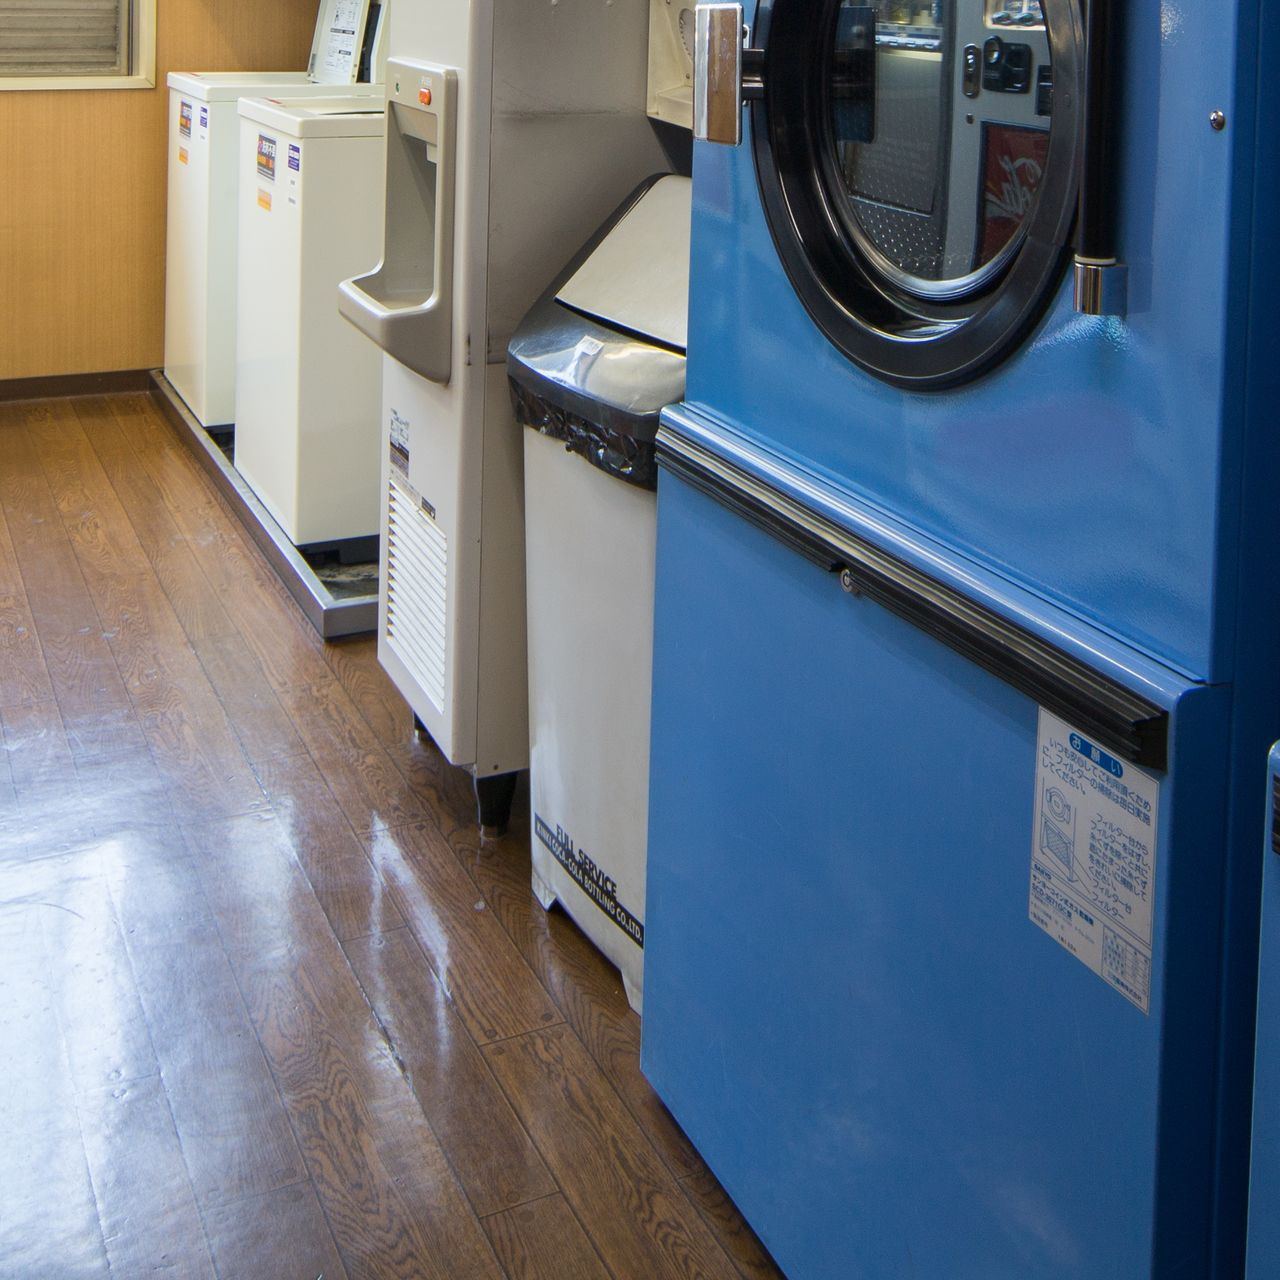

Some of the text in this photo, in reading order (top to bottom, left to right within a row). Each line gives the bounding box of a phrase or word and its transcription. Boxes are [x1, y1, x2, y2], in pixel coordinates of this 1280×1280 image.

[1072, 736, 1121, 776] お願い
[1043, 758, 1086, 795] してください。
[556, 823, 617, 897] FULL SERVICE
[584, 876, 616, 915] BOTTLING
